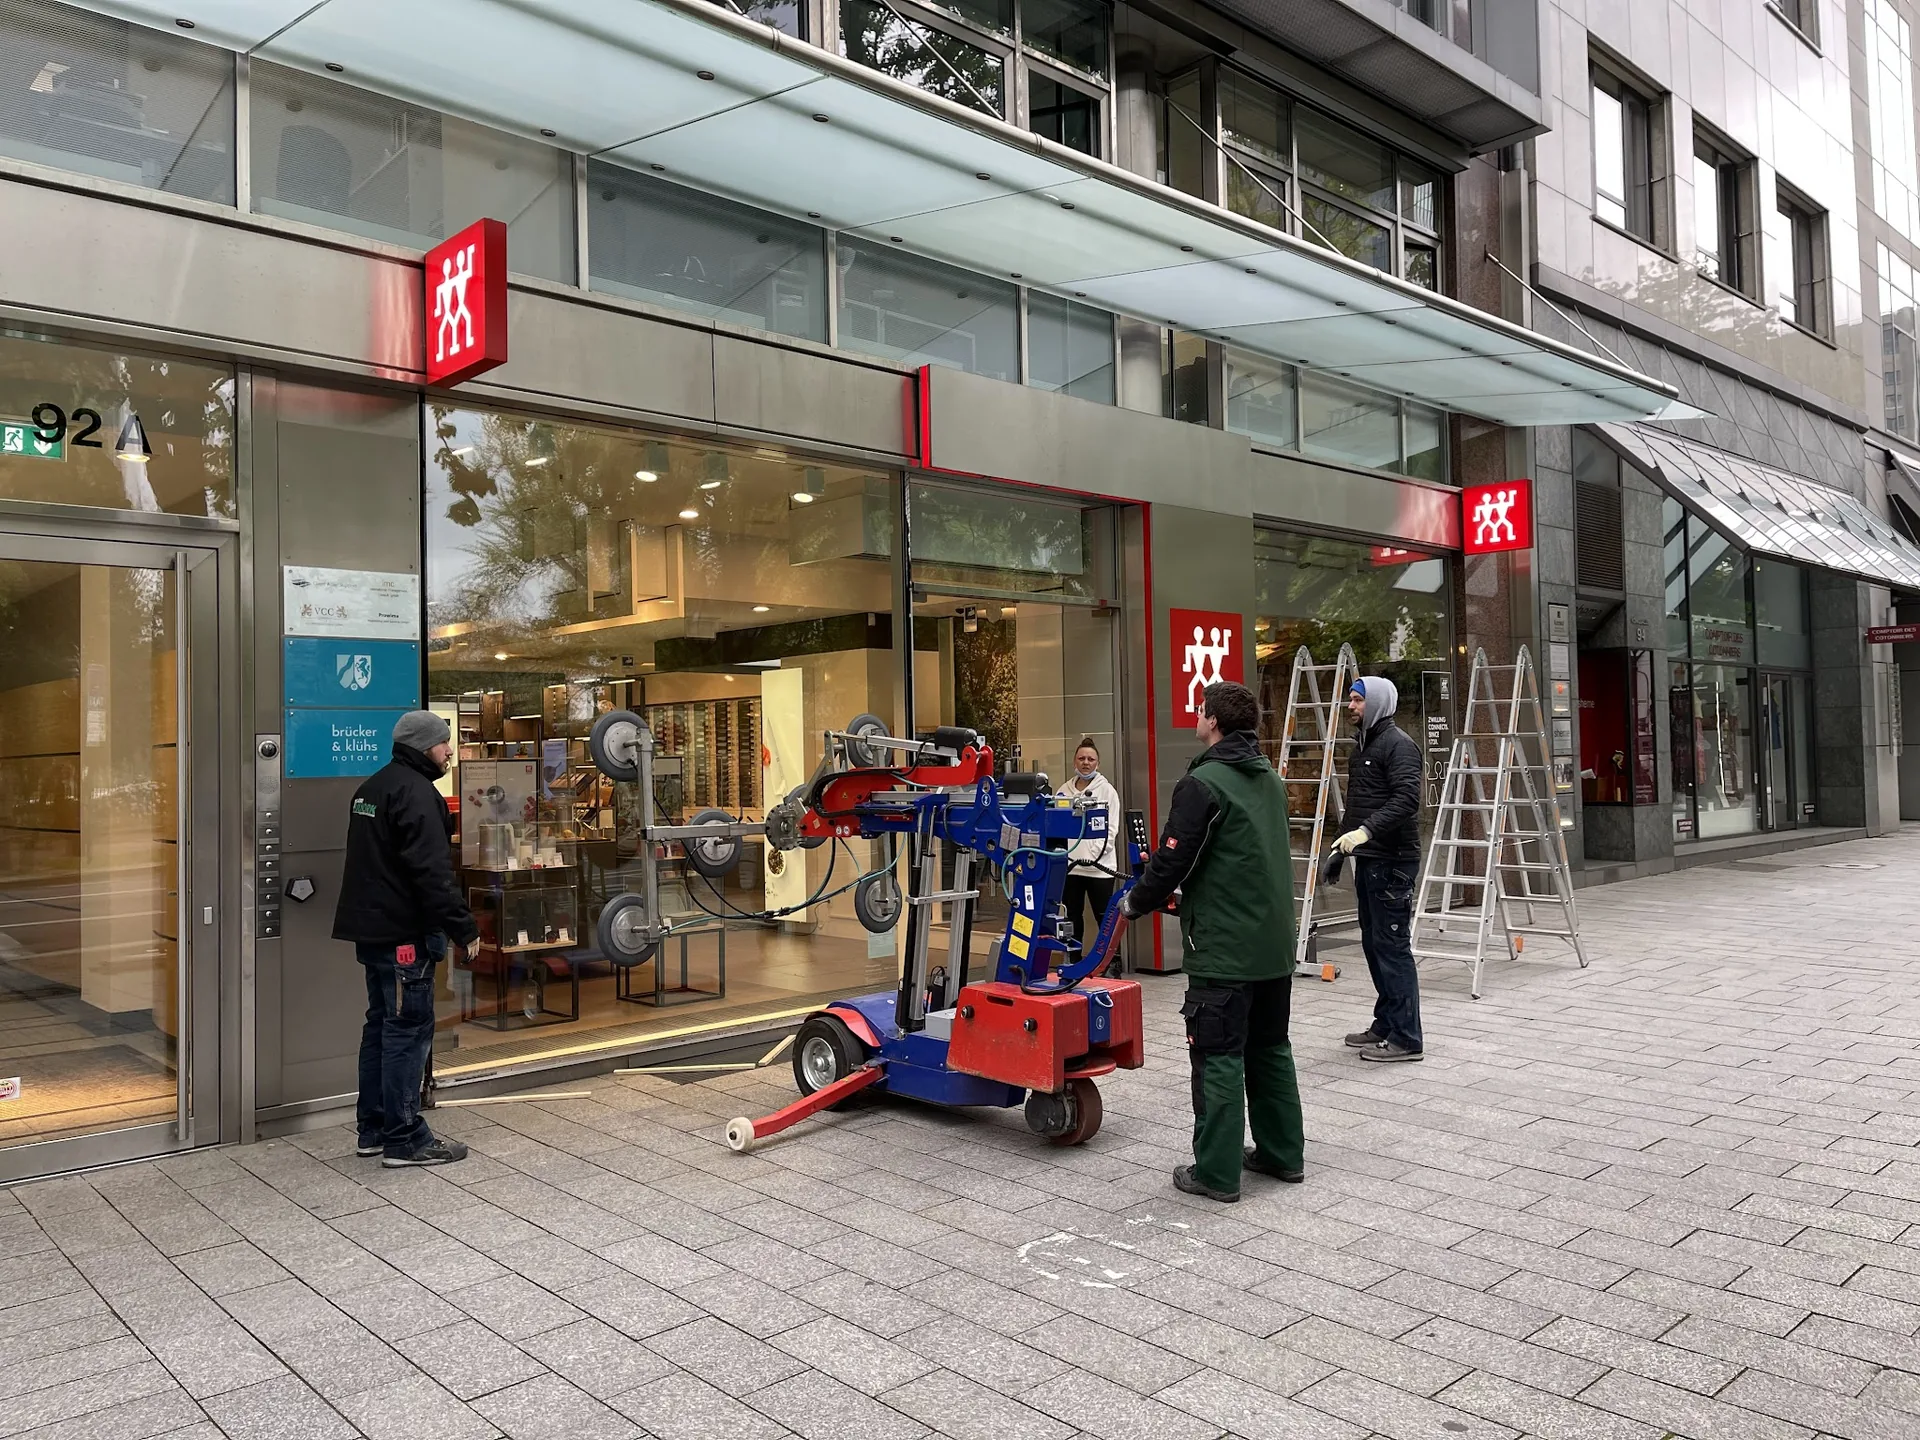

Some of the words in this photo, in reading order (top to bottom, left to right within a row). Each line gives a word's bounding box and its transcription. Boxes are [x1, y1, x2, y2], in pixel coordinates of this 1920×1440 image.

[31, 402, 103, 448] 92
[115, 414, 152, 454] A
[314, 607, 335, 616] VCC
[1636, 628, 1645, 641] 94
[332, 724, 377, 737] brücker
[332, 741, 341, 751] &
[346, 738, 378, 751] klühs
[332, 754, 379, 762] notare
